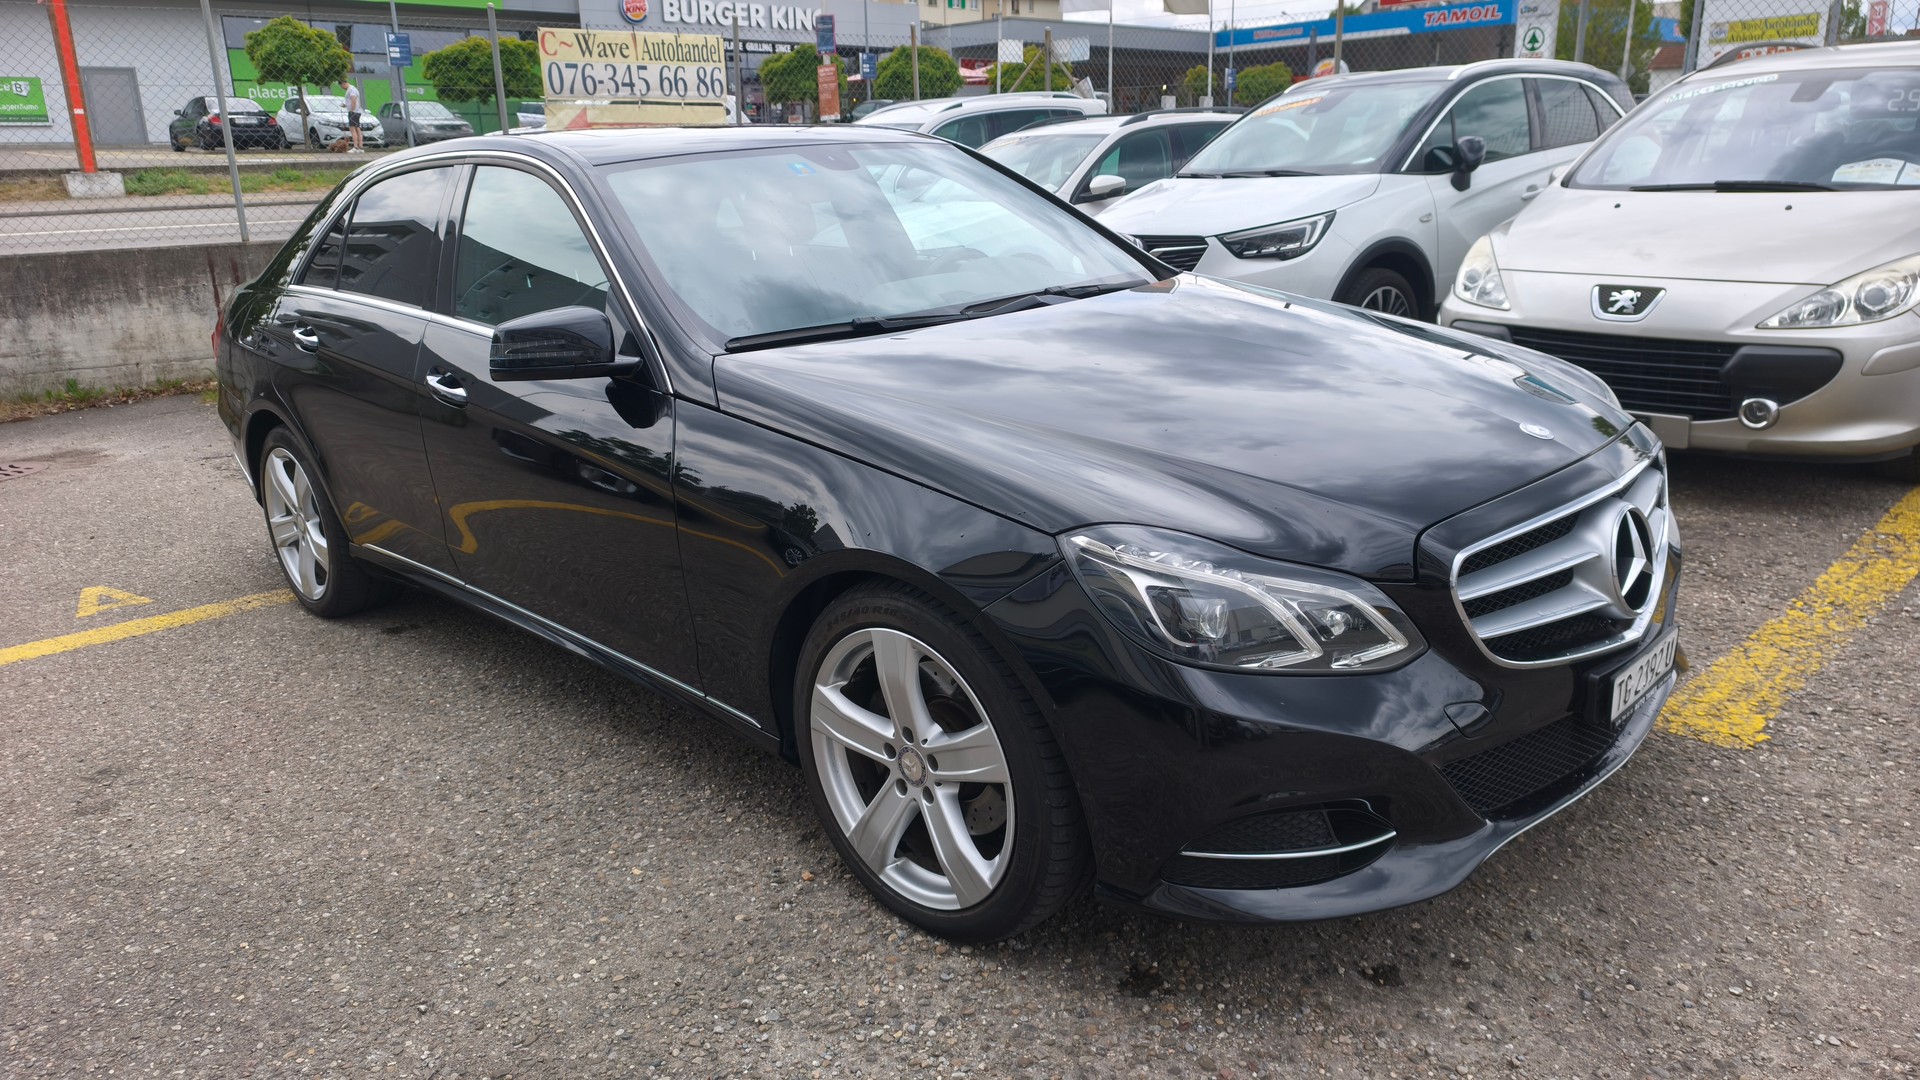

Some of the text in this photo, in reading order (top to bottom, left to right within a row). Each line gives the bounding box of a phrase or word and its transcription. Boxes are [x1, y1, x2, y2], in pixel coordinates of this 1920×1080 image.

[663, 0, 765, 28] BURGER
[1424, 5, 1502, 27] TAMOIL
[641, 35, 722, 63] Autohandel
[248, 85, 286, 99] place
[548, 62, 724, 98] 076-345 66 86
[873, 605, 897, 617] R18
[1617, 673, 1633, 712] TG
[1634, 648, 1664, 696] 2392
[1665, 638, 1676, 668] U
